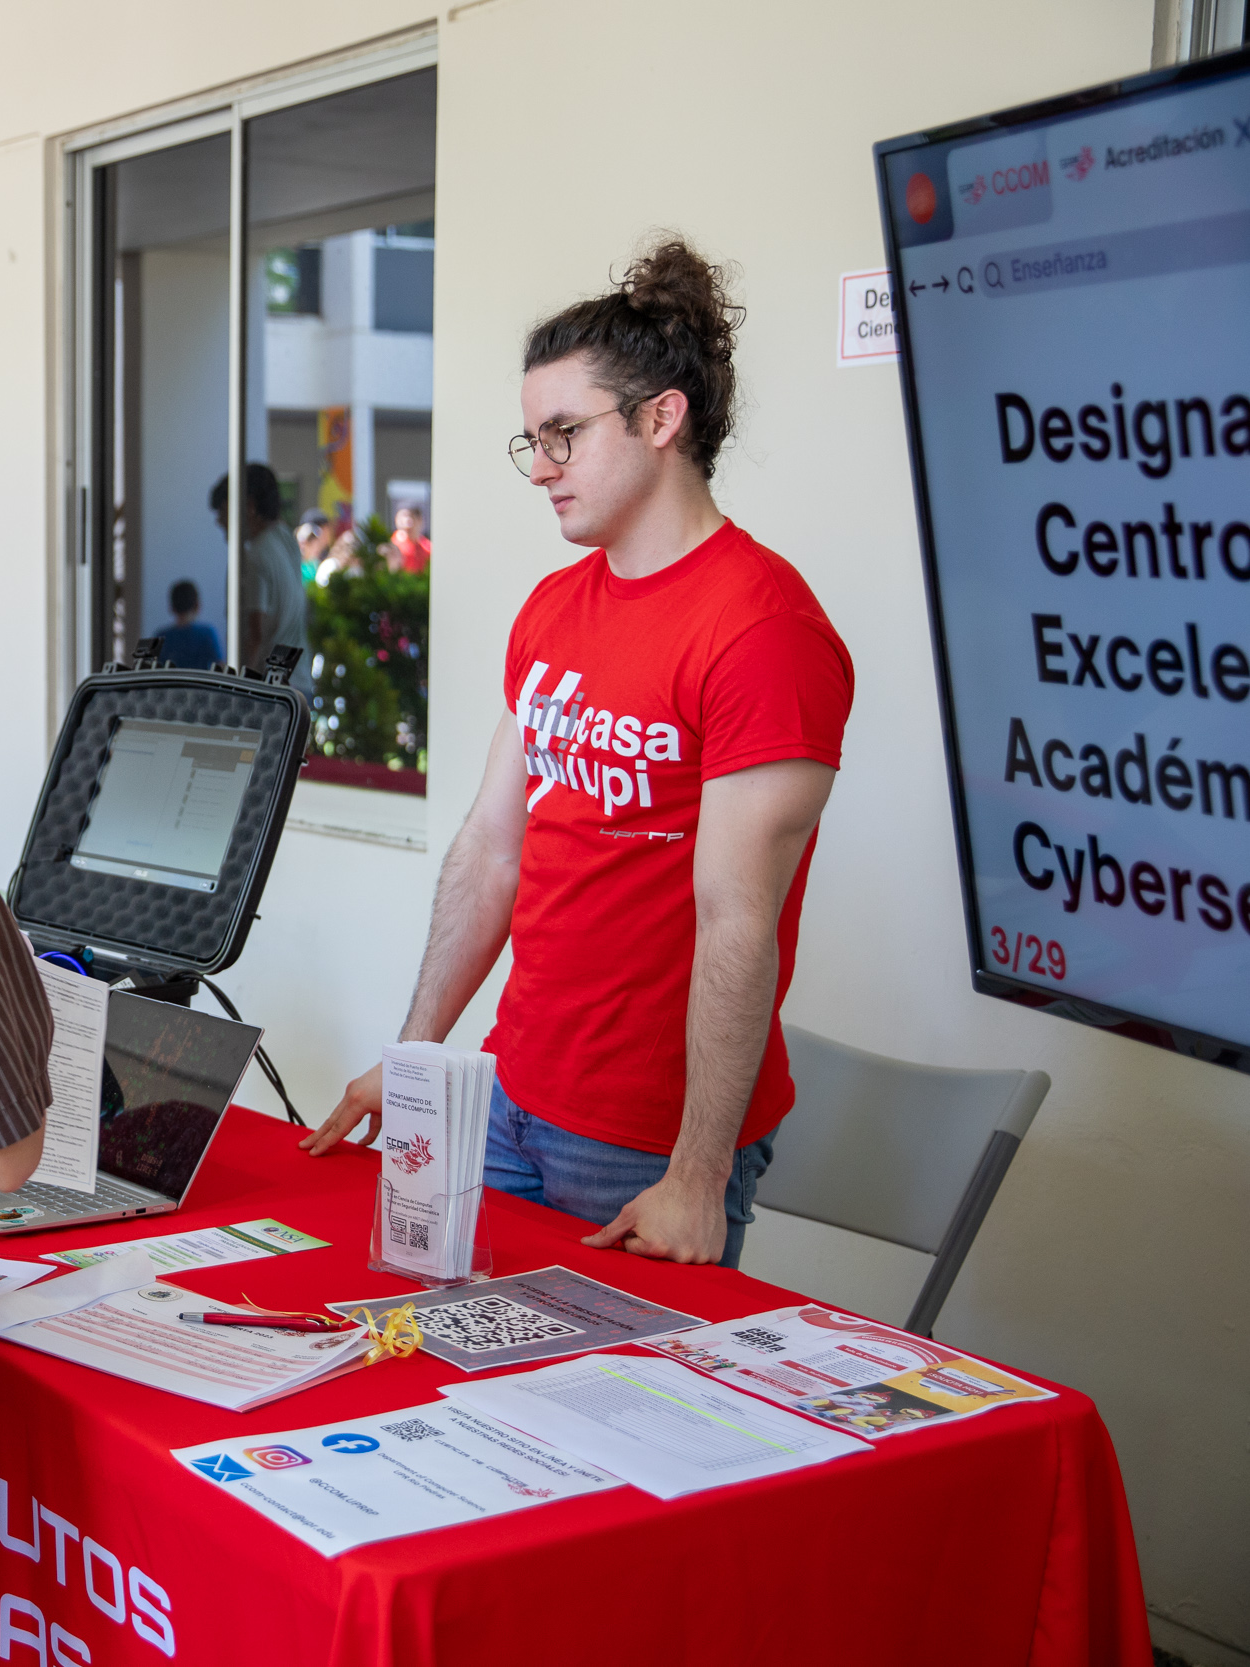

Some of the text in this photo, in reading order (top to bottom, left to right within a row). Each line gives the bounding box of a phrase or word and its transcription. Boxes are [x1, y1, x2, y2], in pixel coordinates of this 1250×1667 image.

[1104, 125, 1225, 169] Acreditación
[991, 160, 1049, 195] CCOM
[1010, 248, 1108, 283] Enseñanza
[865, 289, 891, 309] De
[858, 320, 894, 339] Cien
[994, 382, 1250, 479] Designa
[1035, 501, 1250, 583] Centro
[1031, 613, 1250, 703] Excele
[1004, 717, 1250, 823] Académ
[990, 926, 1067, 981] 3/29
[729, 1330, 788, 1351] ABIERTA
[743, 1327, 785, 1341] CASA
[442, 1405, 472, 1420] ¡VISITA
[470, 1418, 509, 1439] NUESTRO
[507, 1436, 531, 1449] SITIO
[529, 1447, 542, 1455] EN
[541, 1451, 568, 1468] LÍNEA
[573, 1467, 605, 1483] ÚNETE
[456, 1420, 499, 1444] NUESTRAS
[498, 1441, 526, 1457] REDES
[524, 1454, 570, 1478] SOCIALES!
[377, 1452, 419, 1475] Department
[423, 1477, 459, 1497] Computer
[393, 1469, 412, 1480] UPR
[420, 1483, 447, 1500] Piedras
[240, 1481, 336, 1540] ccom-contact@upr.edu
